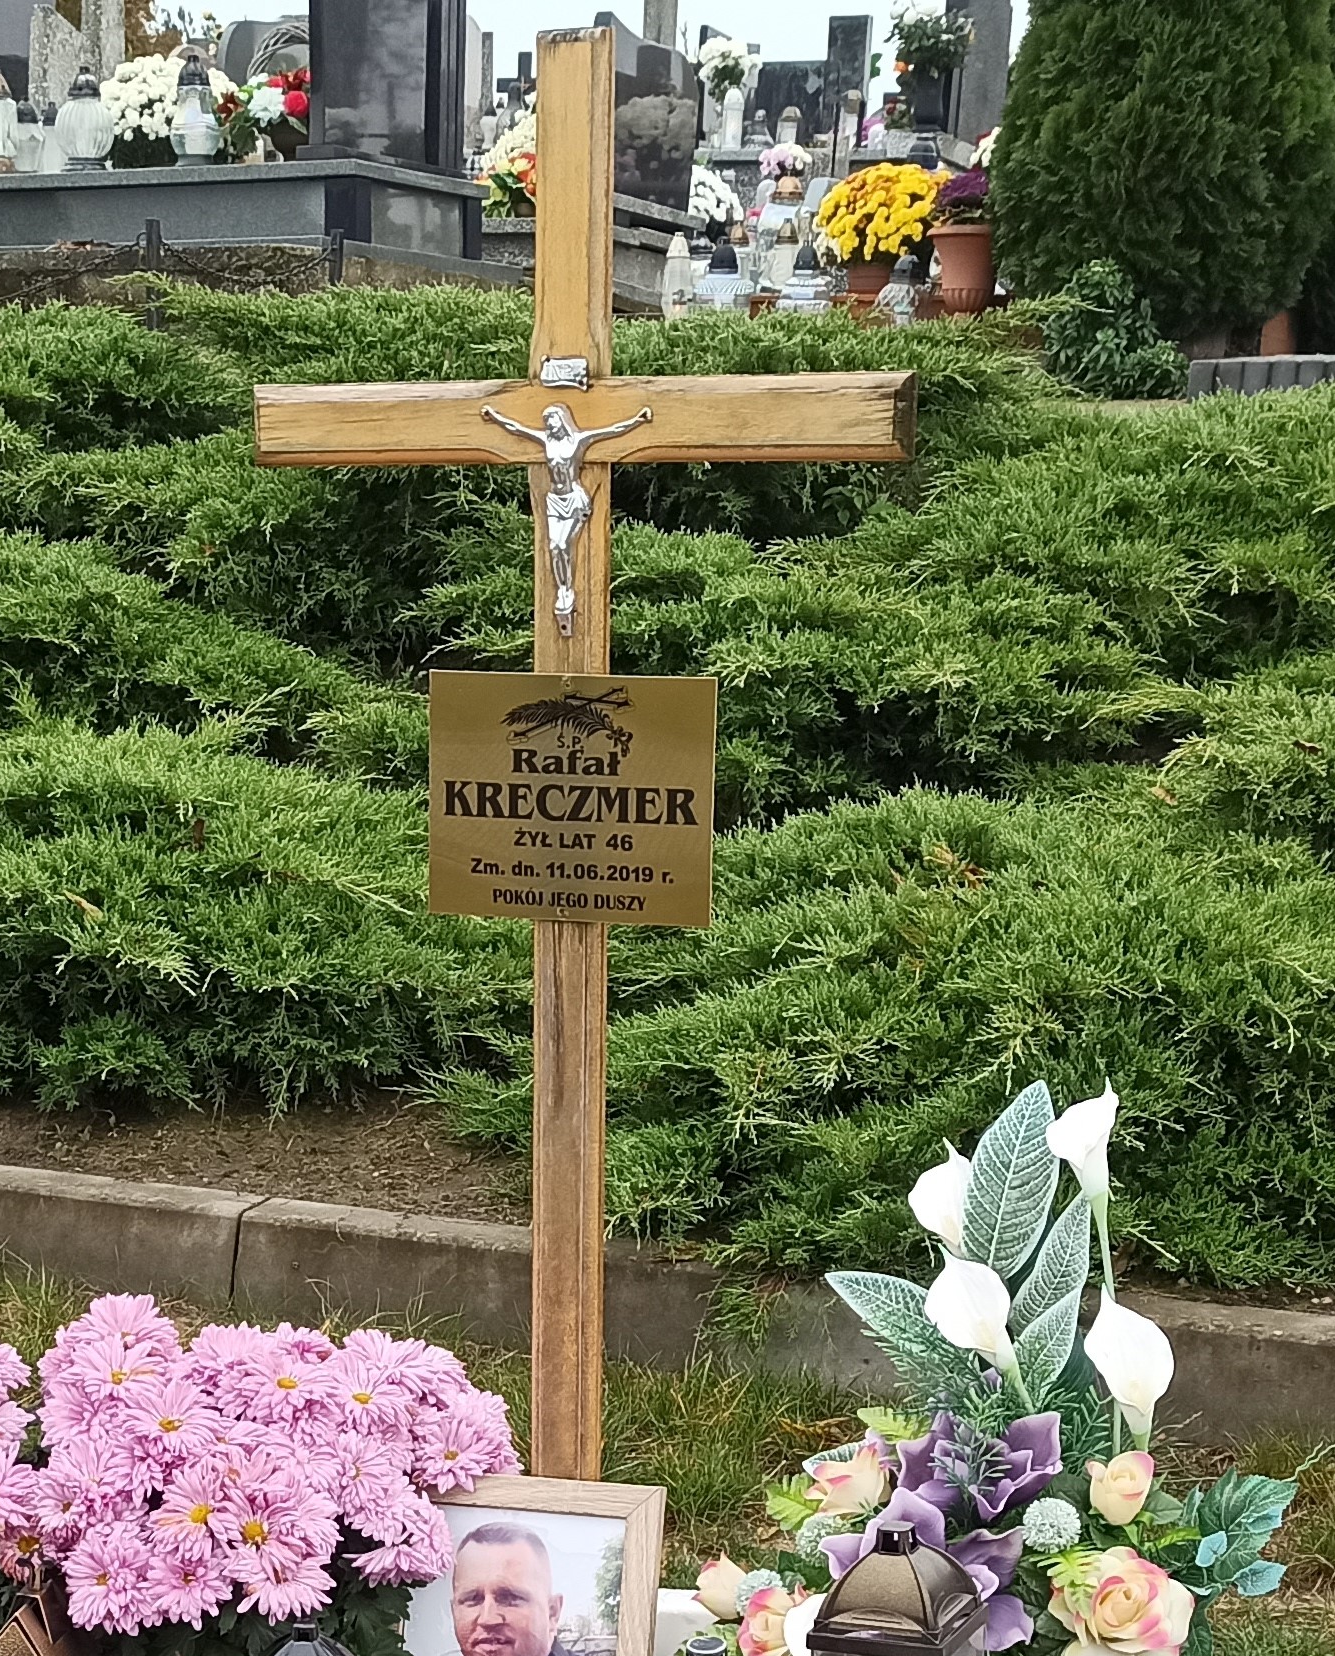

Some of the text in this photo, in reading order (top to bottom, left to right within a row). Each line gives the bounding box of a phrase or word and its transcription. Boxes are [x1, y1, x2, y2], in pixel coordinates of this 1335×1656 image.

[511, 748, 621, 776] Rafał
[443, 779, 699, 826] KRECZMER
[514, 827, 634, 852] ŻYŁ LAT 46
[470, 857, 675, 885] Zm. dn. 11.06.2019 r.
[492, 886, 647, 912] POKÓJ JEGO DUSZY
